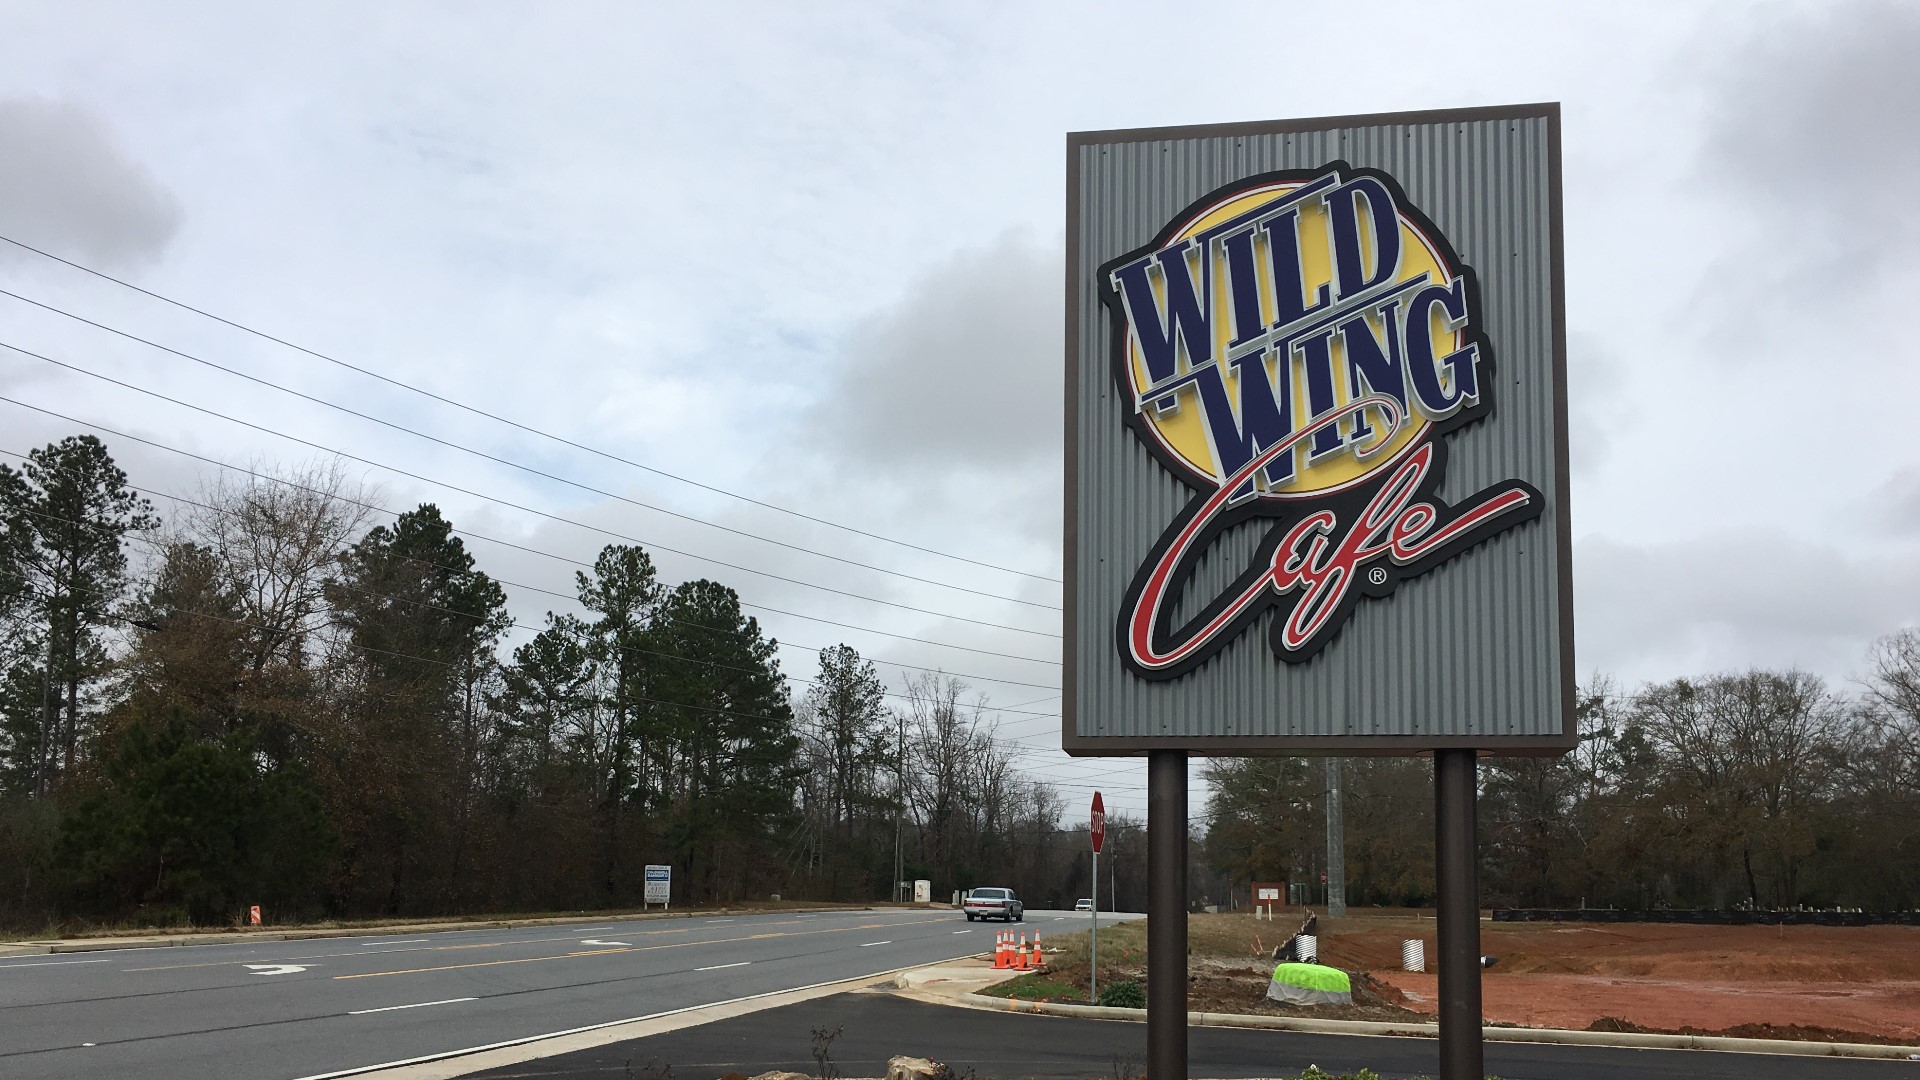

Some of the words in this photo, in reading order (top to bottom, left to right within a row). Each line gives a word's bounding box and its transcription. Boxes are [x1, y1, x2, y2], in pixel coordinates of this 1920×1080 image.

[1110, 172, 1401, 387] WILD
[1136, 272, 1481, 505] WING
[1129, 393, 1530, 669] Cafe
[1091, 810, 1104, 834] STOP
